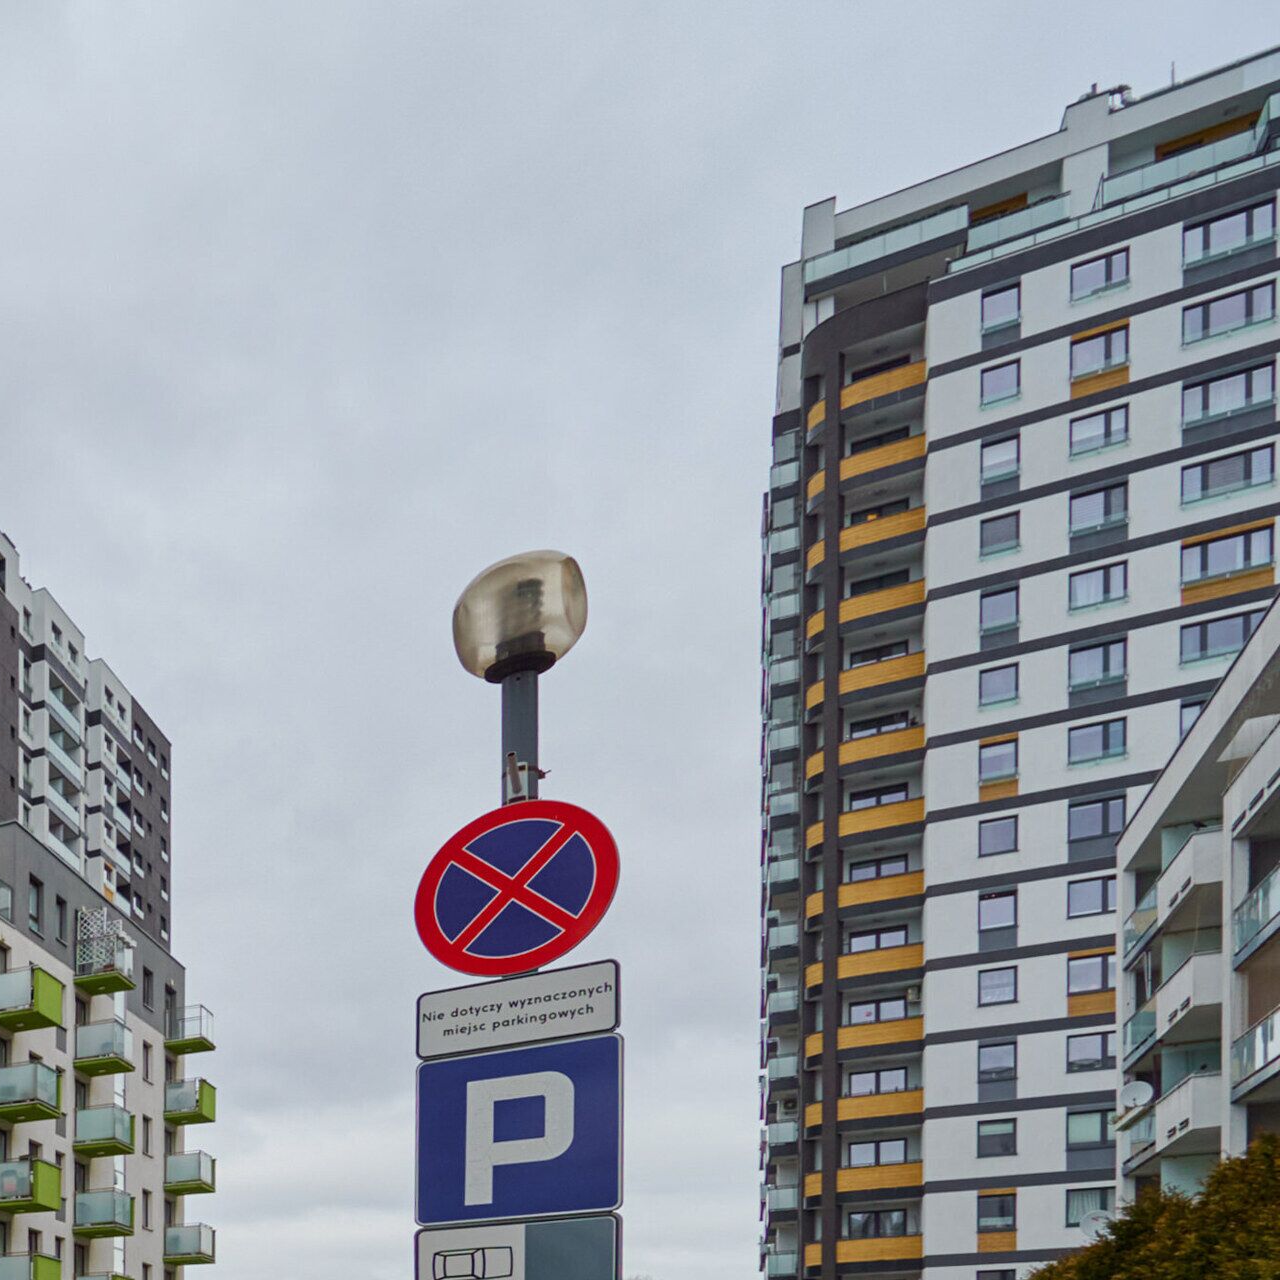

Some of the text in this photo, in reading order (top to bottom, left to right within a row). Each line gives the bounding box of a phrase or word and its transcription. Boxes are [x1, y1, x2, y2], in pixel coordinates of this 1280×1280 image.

[422, 982, 613, 1023] Nie dotyczy wyznaczonych
[443, 1004, 594, 1037] miejsc parkingowych
[464, 1071, 575, 1206] P
